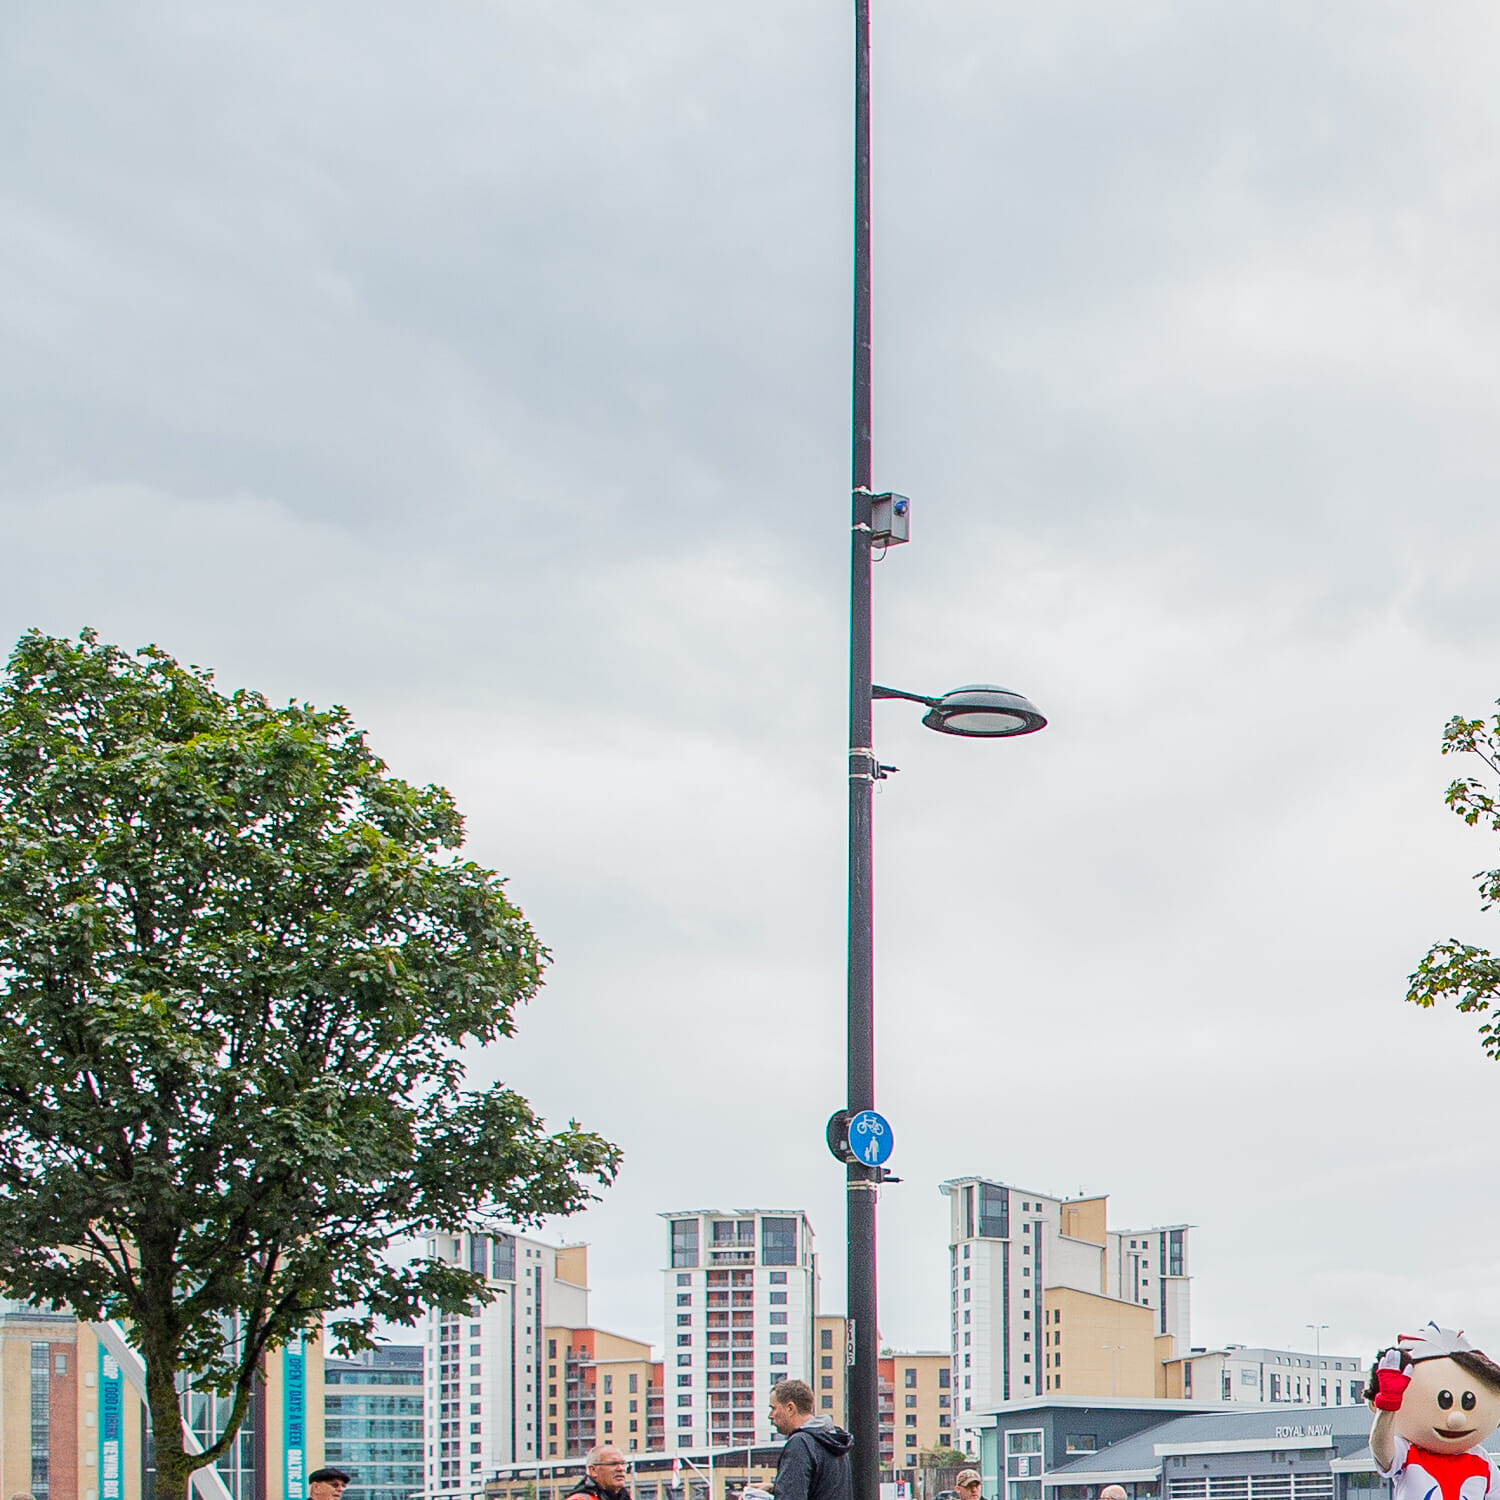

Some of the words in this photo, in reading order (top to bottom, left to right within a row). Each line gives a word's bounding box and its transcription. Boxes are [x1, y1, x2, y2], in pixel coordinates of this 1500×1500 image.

[103, 1355, 118, 1379] SHOP
[289, 1359, 302, 1380] OPEN
[104, 1382, 118, 1404] FOOD
[289, 1391, 302, 1412] DAYS
[289, 1423, 302, 1446] WEEK
[1275, 1425, 1305, 1438] ROYAL
[1307, 1424, 1333, 1436] NAVY
[103, 1441, 119, 1479] VIEWING
[287, 1449, 303, 1499] BALTIC.ART
[103, 1480, 119, 1498] BOX
